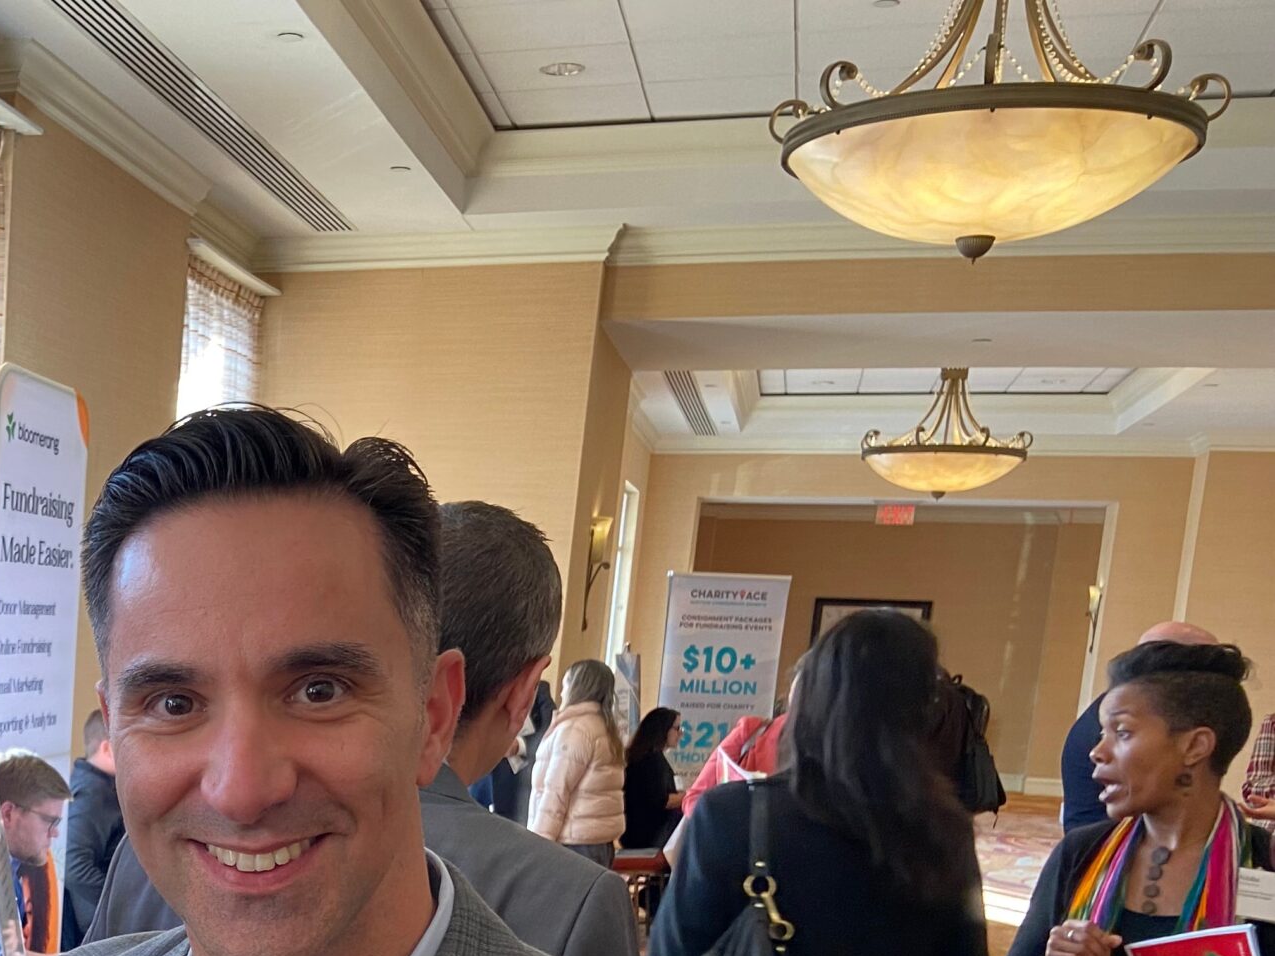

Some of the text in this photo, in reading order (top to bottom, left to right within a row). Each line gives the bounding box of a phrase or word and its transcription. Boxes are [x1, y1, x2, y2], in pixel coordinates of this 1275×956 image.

[18, 422, 60, 455] bloomerang
[3, 482, 74, 527] Fundraising
[0, 536, 74, 570] Made Easier.
[690, 589, 738, 600] CHARITY
[19, 600, 56, 620] Management
[681, 615, 733, 623] CONSIGNMENT
[696, 622, 743, 630] FUNDRAISING
[17, 639, 52, 657] Fundraising
[682, 644, 756, 674] $10+
[13, 677, 44, 694] Marketing
[679, 679, 757, 696] MILLION
[680, 702, 756, 711] RAISED FOR CHARITY
